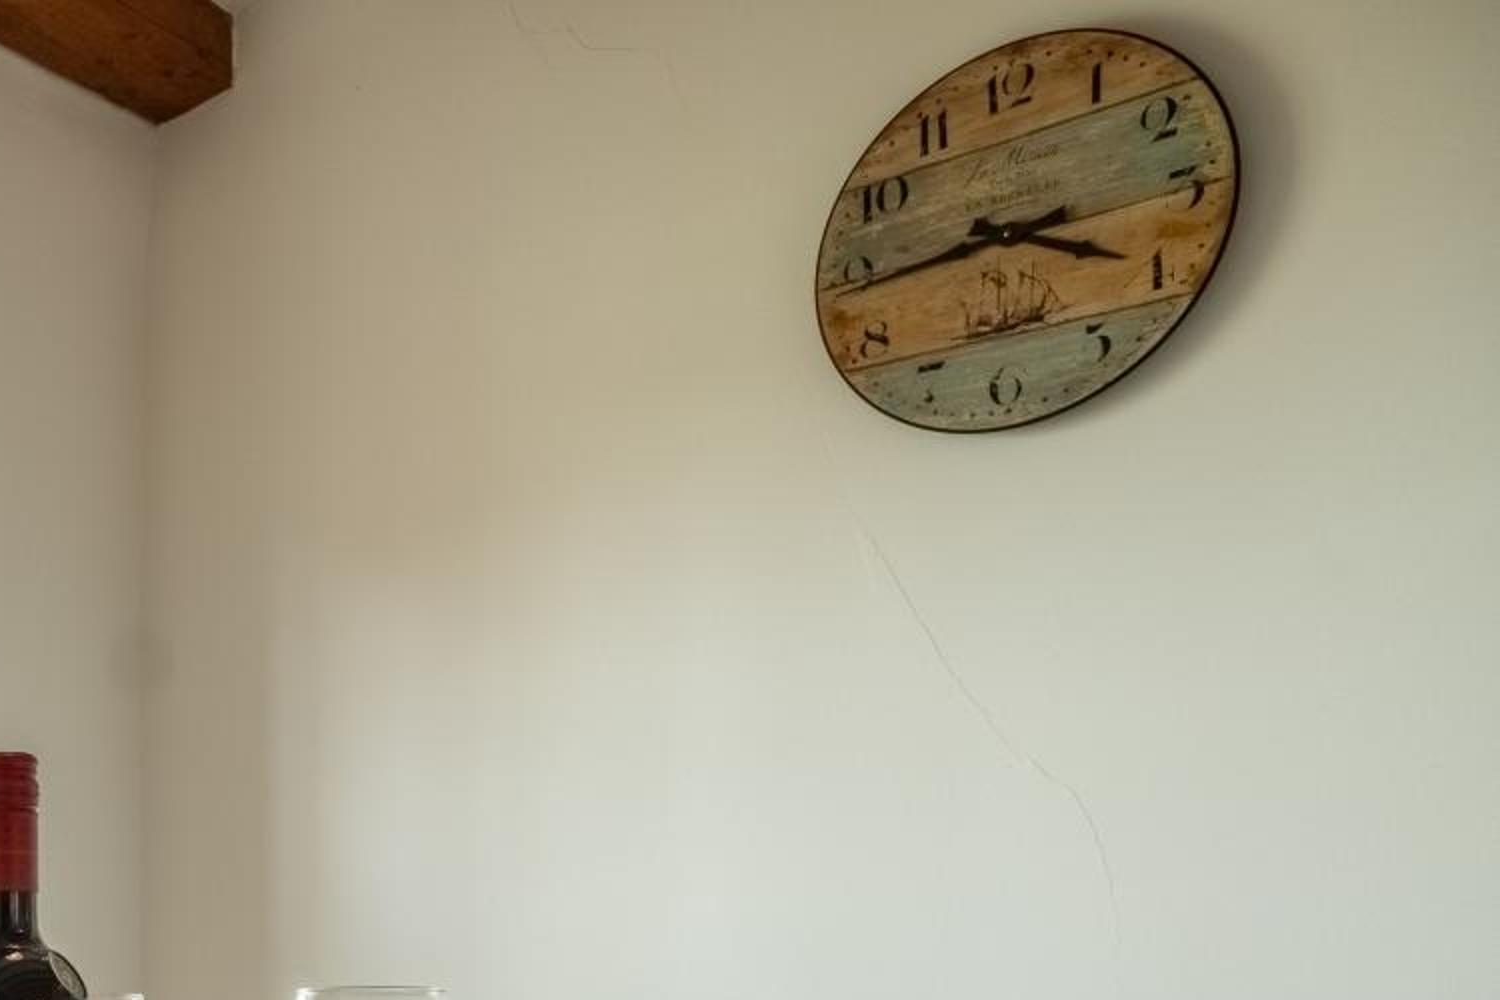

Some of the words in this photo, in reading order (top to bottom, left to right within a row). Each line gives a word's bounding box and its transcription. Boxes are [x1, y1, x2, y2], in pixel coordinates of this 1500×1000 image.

[986, 62, 1036, 116] 12
[1091, 62, 1103, 105] 1
[919, 108, 949, 157] 11
[1140, 96, 1179, 143] 2
[860, 175, 909, 224] 10
[1169, 165, 1206, 209] 3
[859, 321, 889, 359] 8
[989, 367, 1023, 406] 6
